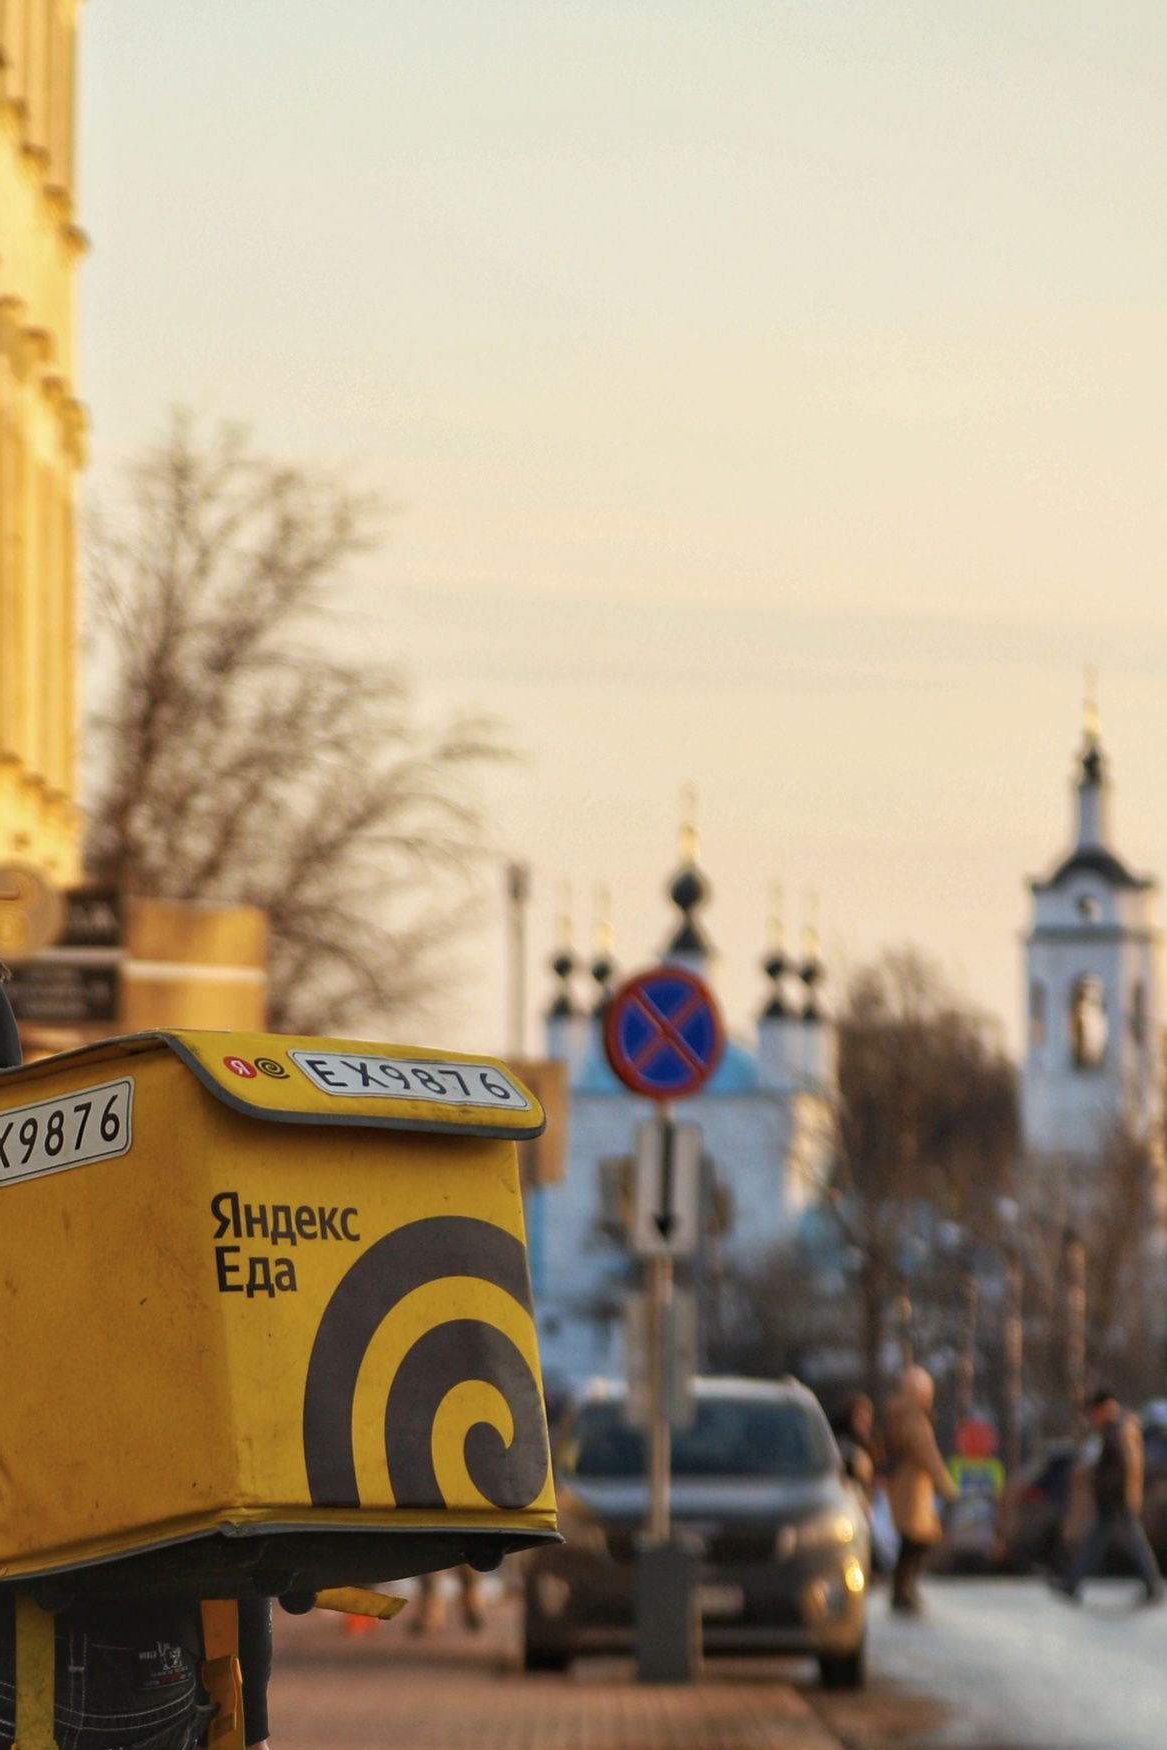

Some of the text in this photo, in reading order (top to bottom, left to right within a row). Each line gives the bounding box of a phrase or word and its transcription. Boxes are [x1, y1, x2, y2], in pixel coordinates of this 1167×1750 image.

[306, 1060, 511, 1100] EX9876
[211, 1192, 361, 1246] Яндекс
[214, 1246, 298, 1298] Еда
